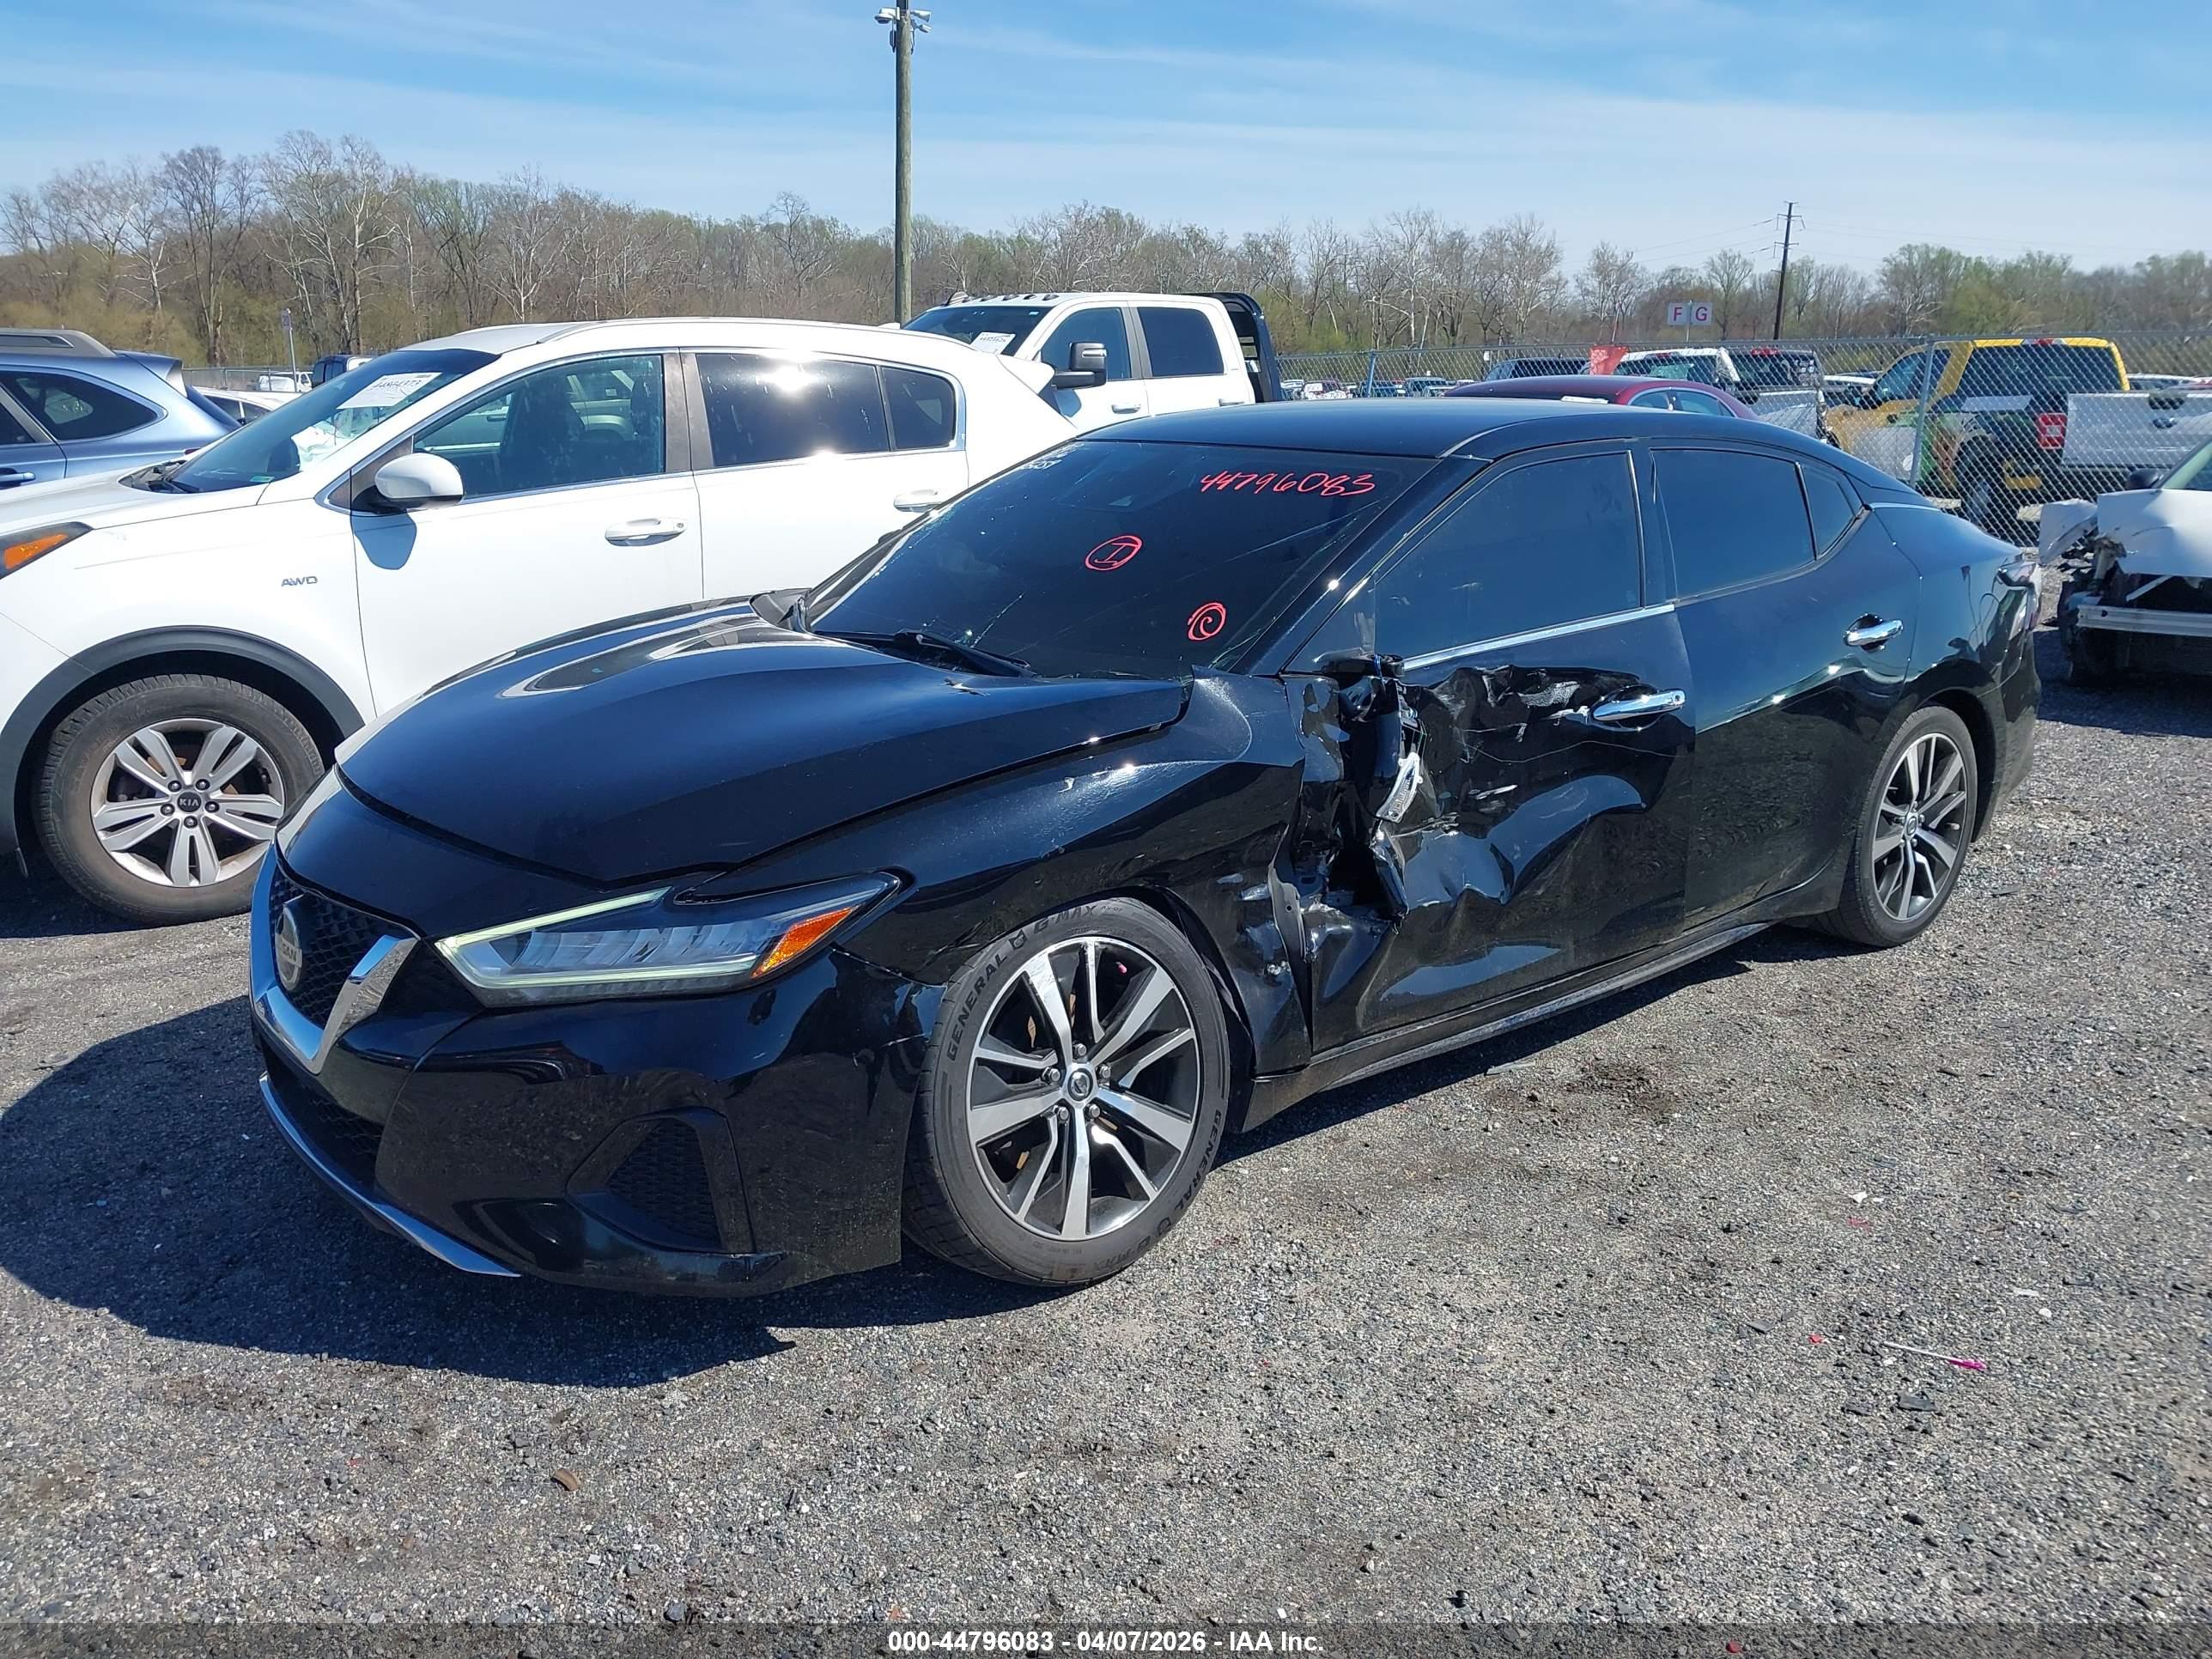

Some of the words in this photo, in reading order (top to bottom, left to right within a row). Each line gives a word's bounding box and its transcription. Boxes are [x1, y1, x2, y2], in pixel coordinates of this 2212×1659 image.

[1673, 307, 1683, 321] F
[1695, 306, 1708, 321] G
[1200, 470, 1376, 496] 44796083
[281, 575, 319, 587] AWD
[179, 798, 199, 806] KIA
[945, 953, 1008, 1061] GENERAL
[1174, 1109, 1222, 1212] GENERAL
